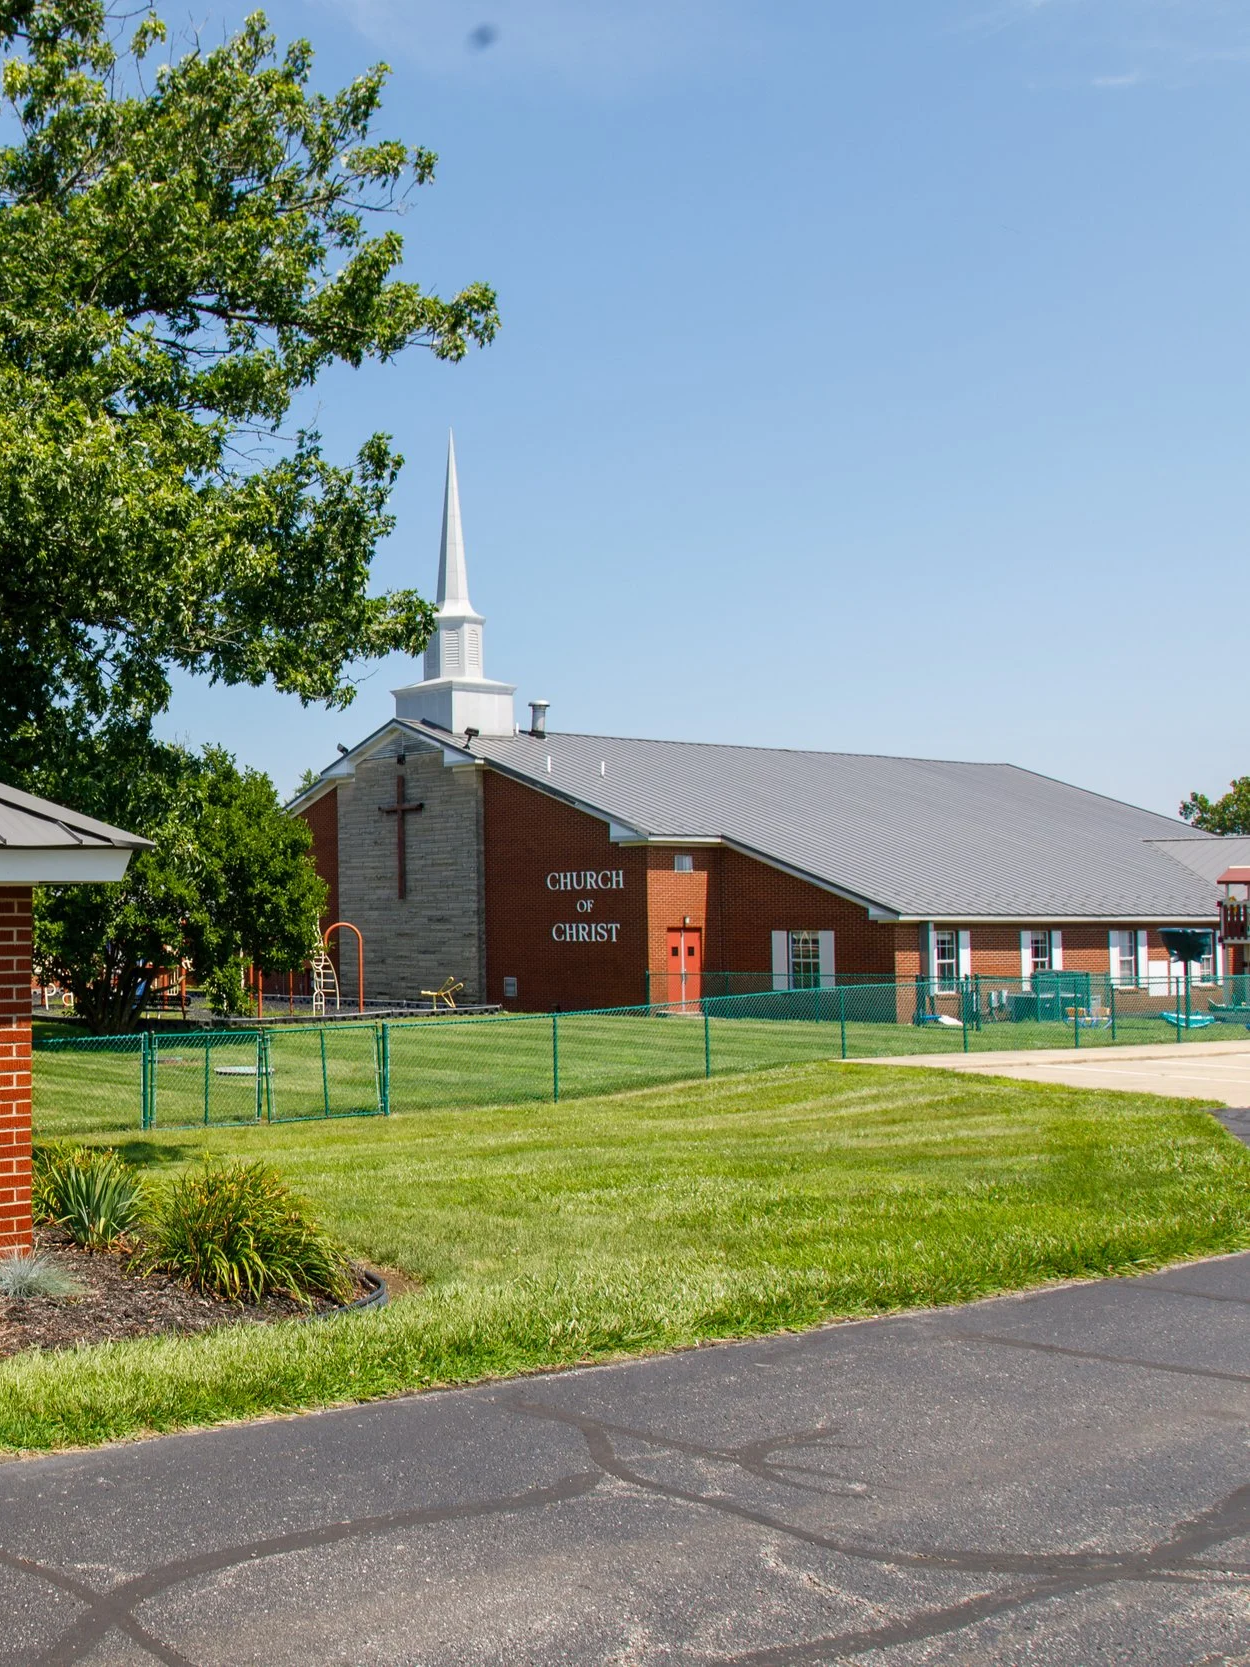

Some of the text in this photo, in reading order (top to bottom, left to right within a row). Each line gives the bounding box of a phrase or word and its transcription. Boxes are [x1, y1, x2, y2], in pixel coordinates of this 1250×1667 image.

[546, 870, 624, 890] CHURCH
[576, 900, 594, 912] OF
[552, 923, 620, 942] CHRIST
